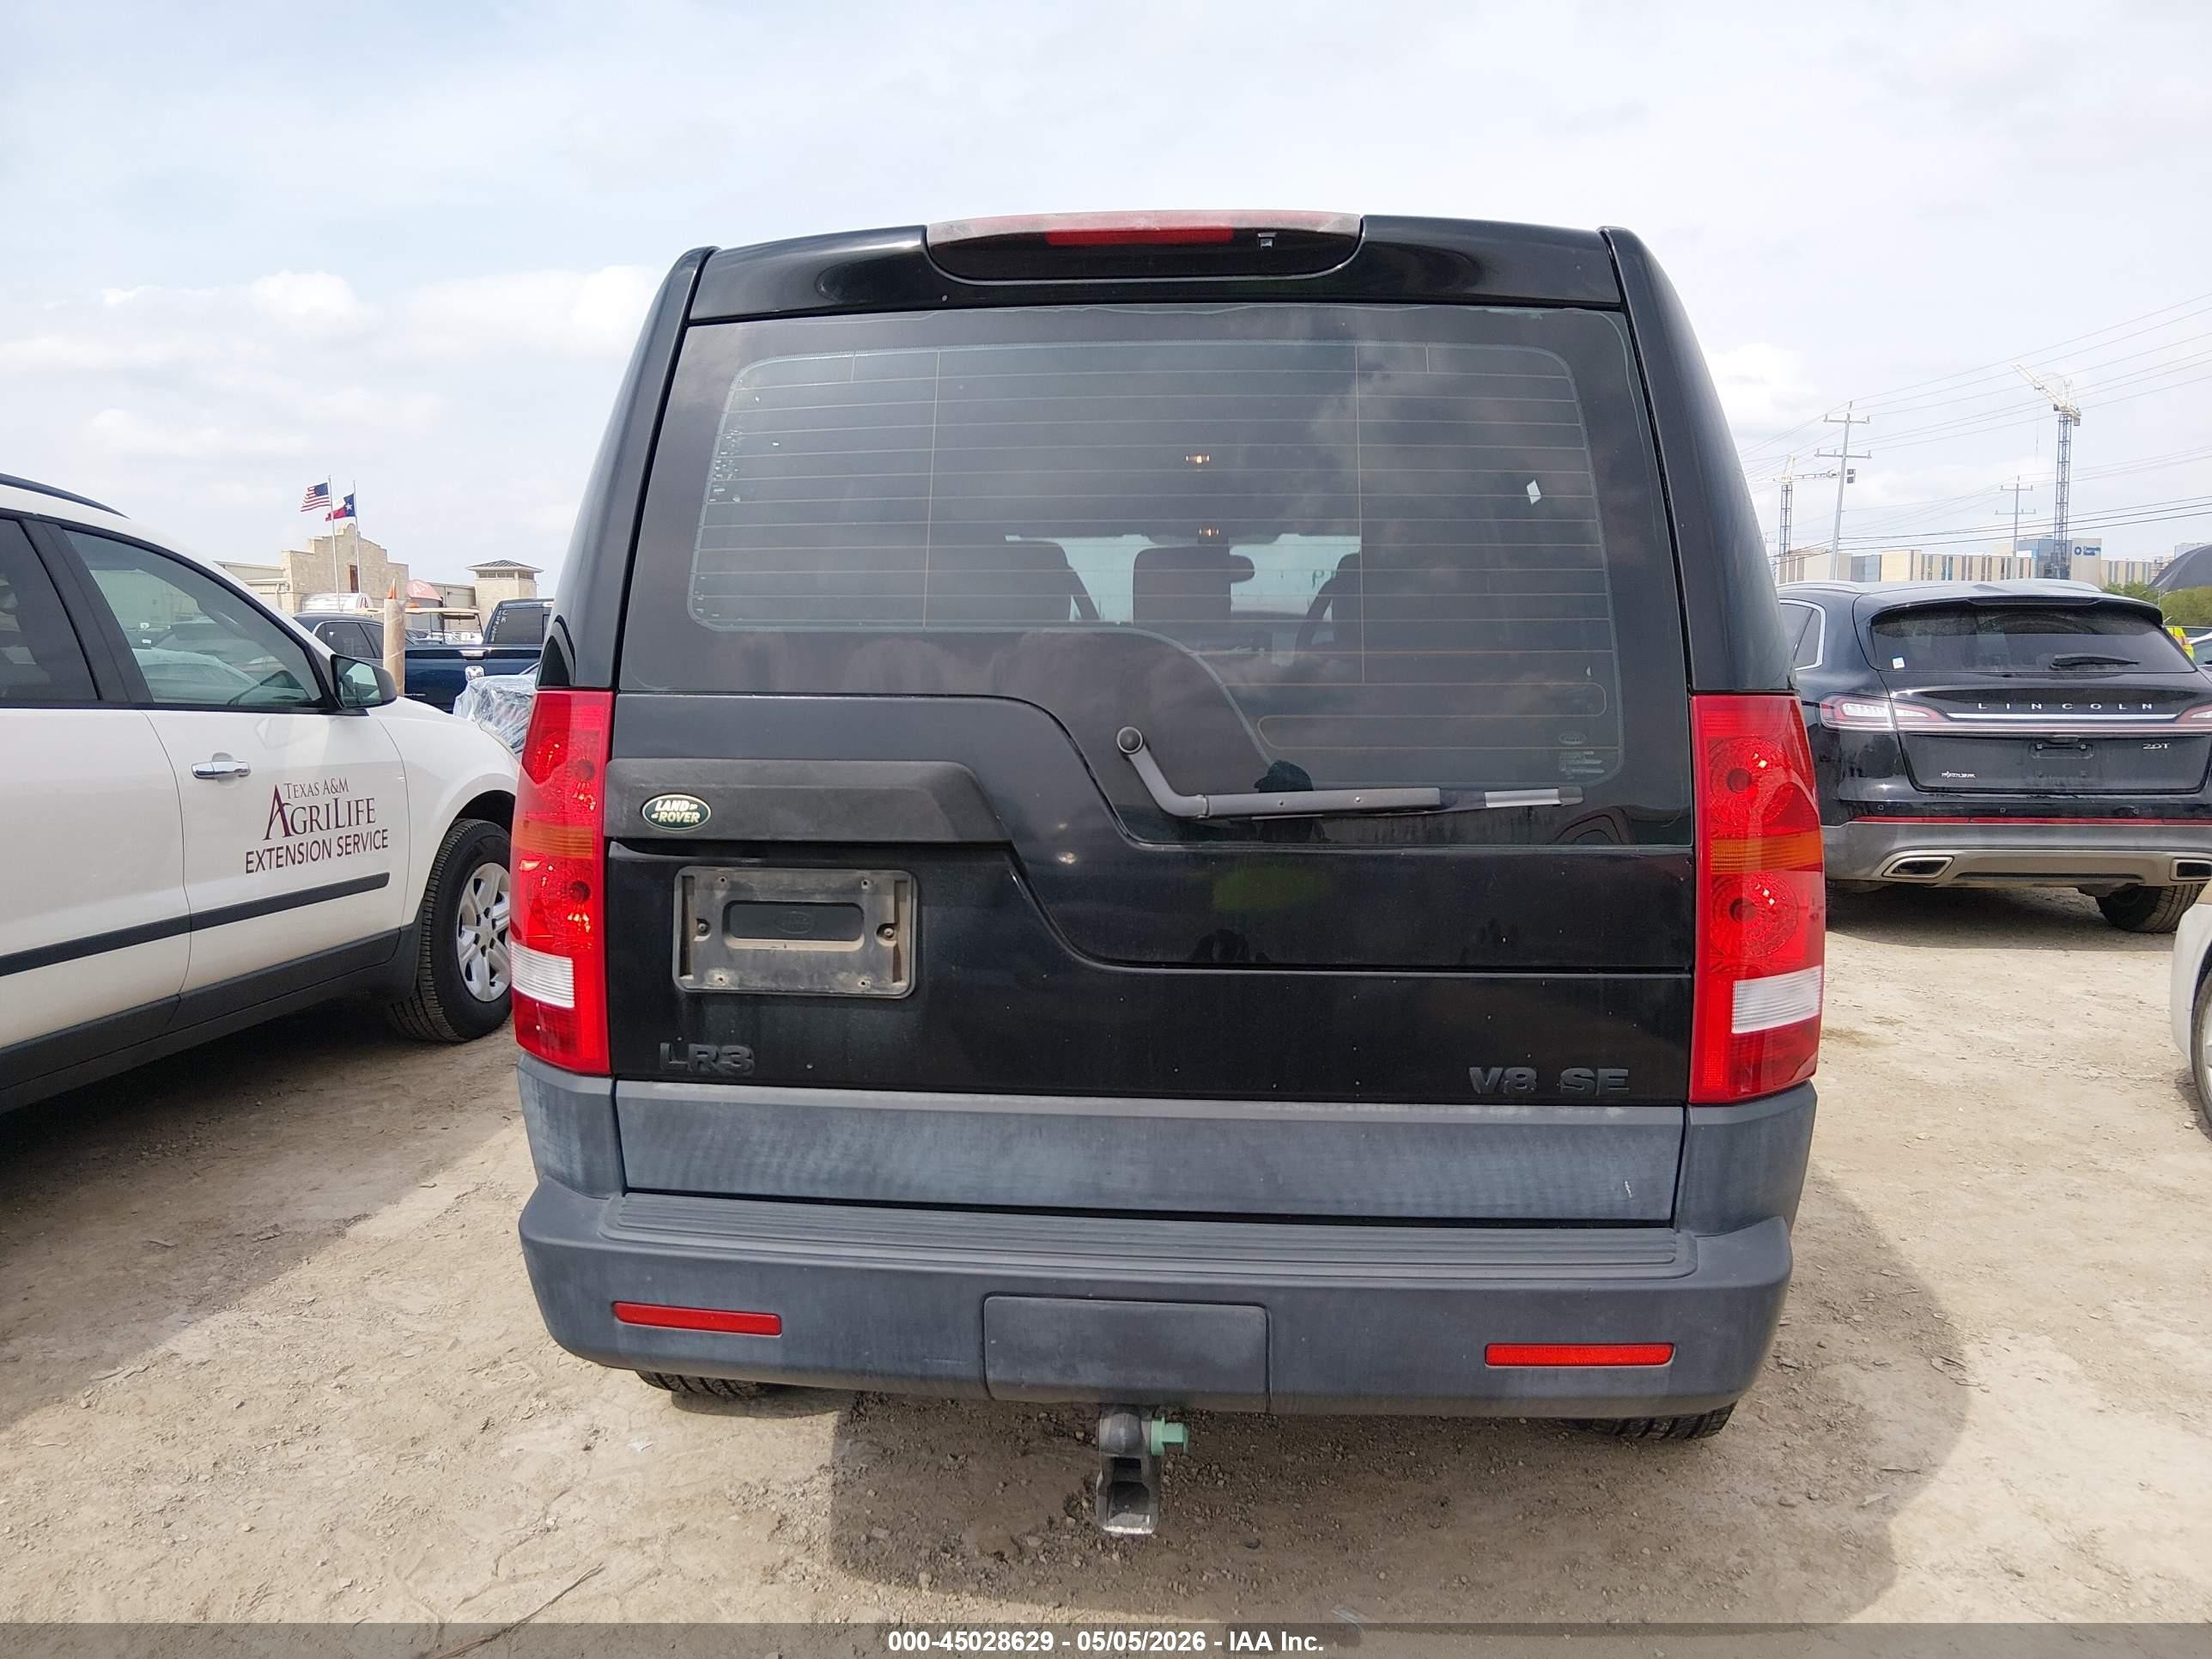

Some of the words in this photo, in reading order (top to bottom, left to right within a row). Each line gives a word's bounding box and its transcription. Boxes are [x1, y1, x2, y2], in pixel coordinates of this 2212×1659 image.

[323, 777, 349, 793] A&M
[655, 800, 690, 811] LAND
[659, 811, 701, 823] ROVER
[245, 839, 333, 874] EXTENSION
[336, 828, 389, 857] SERVICE
[659, 1042, 754, 1075] LR3
[1468, 1066, 1538, 1095] V8
[1559, 1067, 1630, 1096] SE
